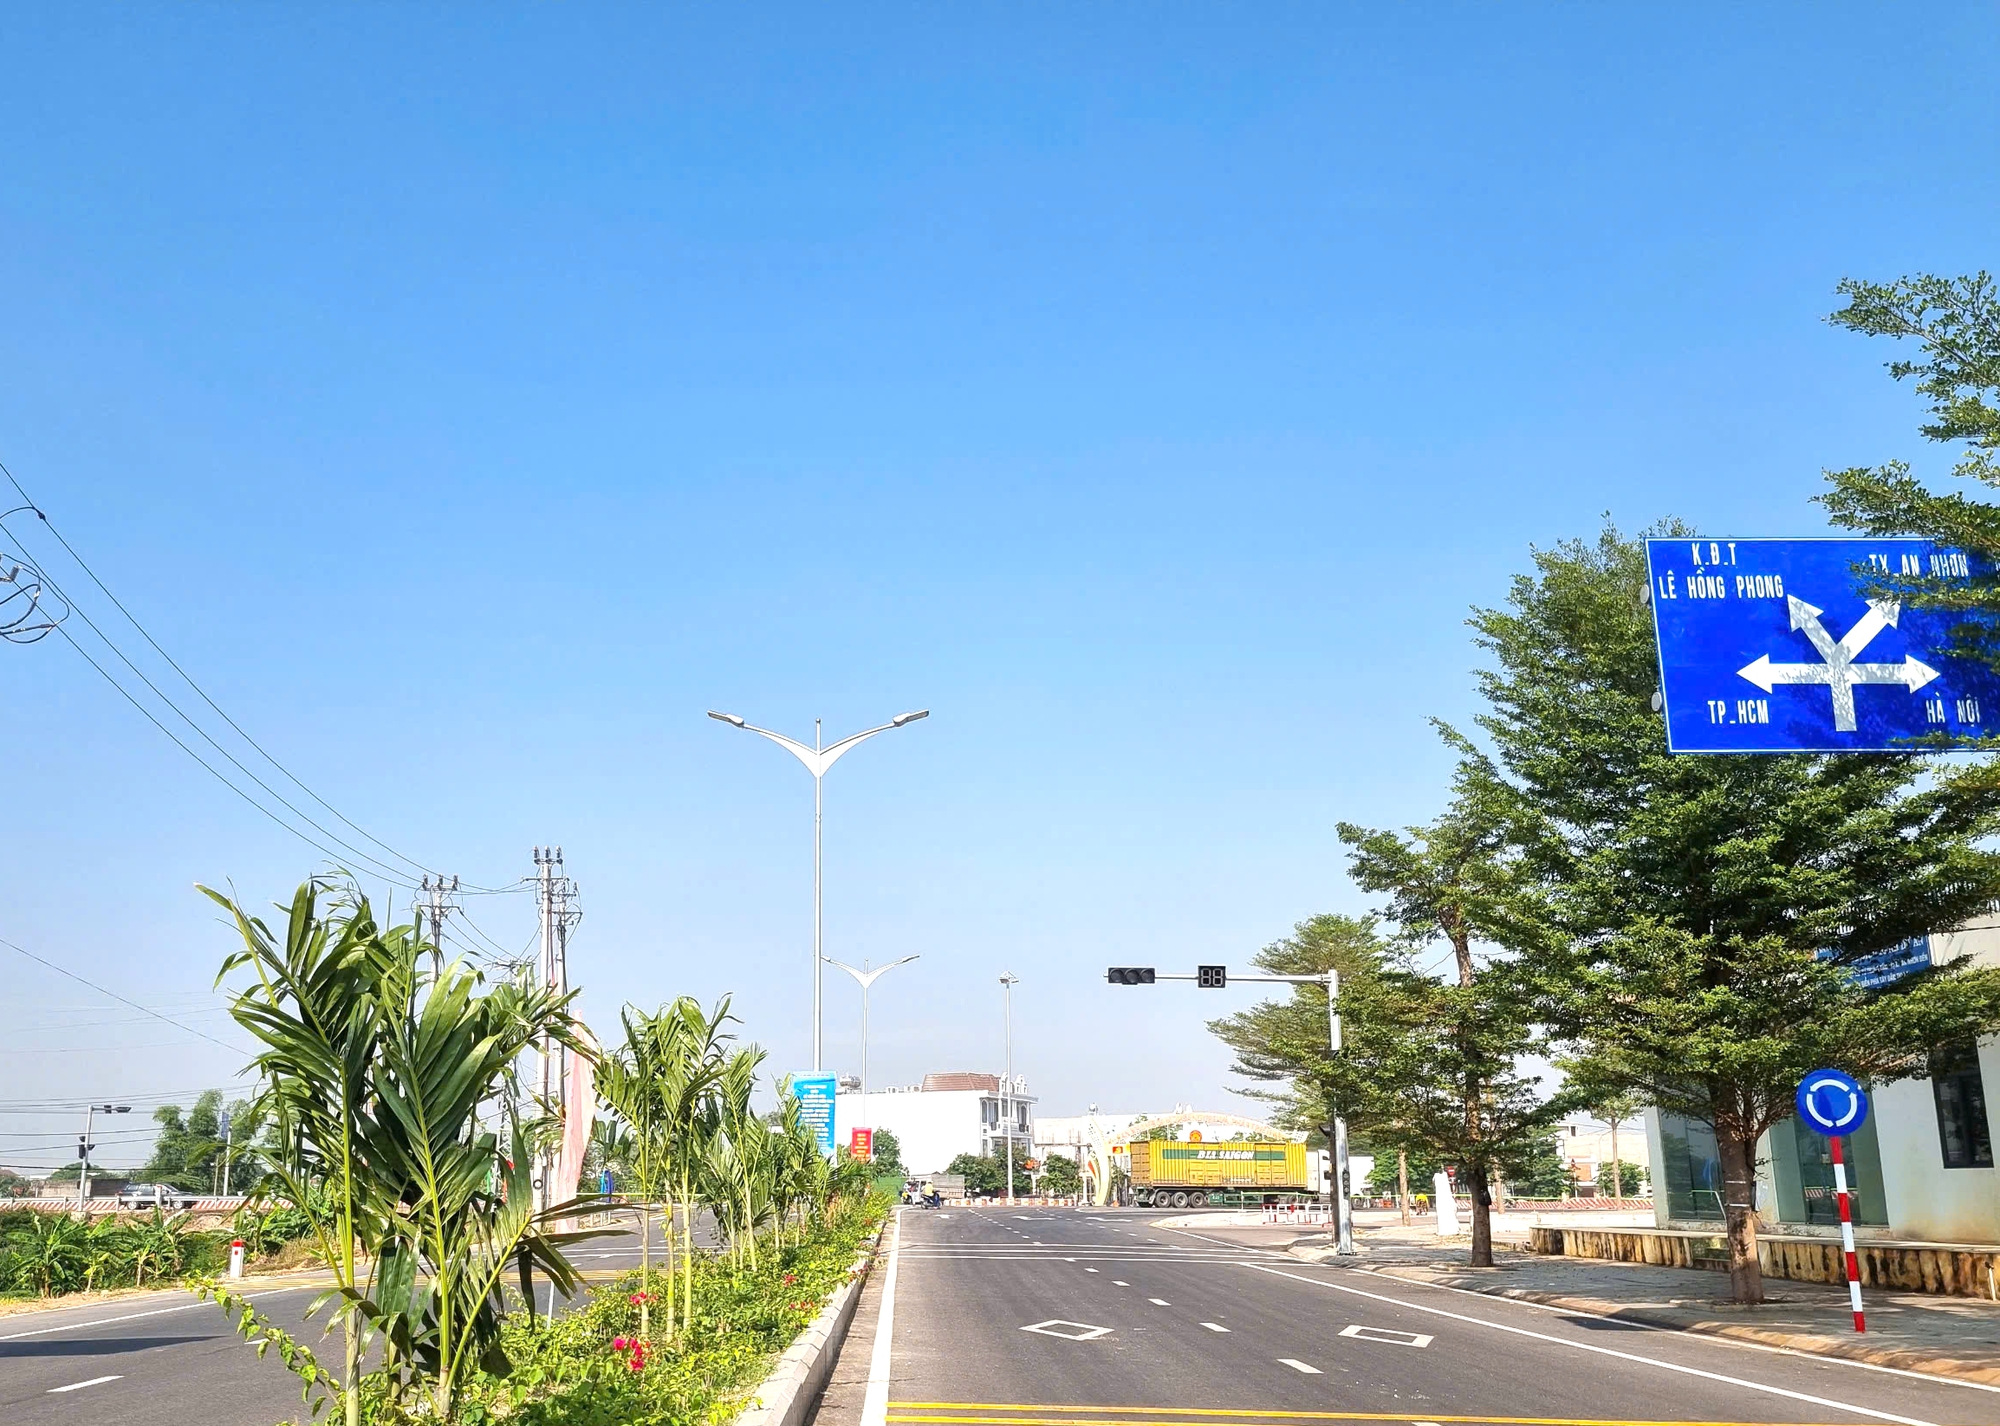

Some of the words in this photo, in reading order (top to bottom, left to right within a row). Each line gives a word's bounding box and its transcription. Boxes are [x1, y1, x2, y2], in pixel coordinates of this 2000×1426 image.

[1691, 542, 1737, 566] K.Đ.T
[1658, 569, 1677, 599] LÊ
[1686, 566, 1726, 599] HỒNG
[1735, 574, 1784, 599] PHONG
[1925, 691, 1946, 723] HÀ
[1219, 1150, 1255, 1160] SAIGON
